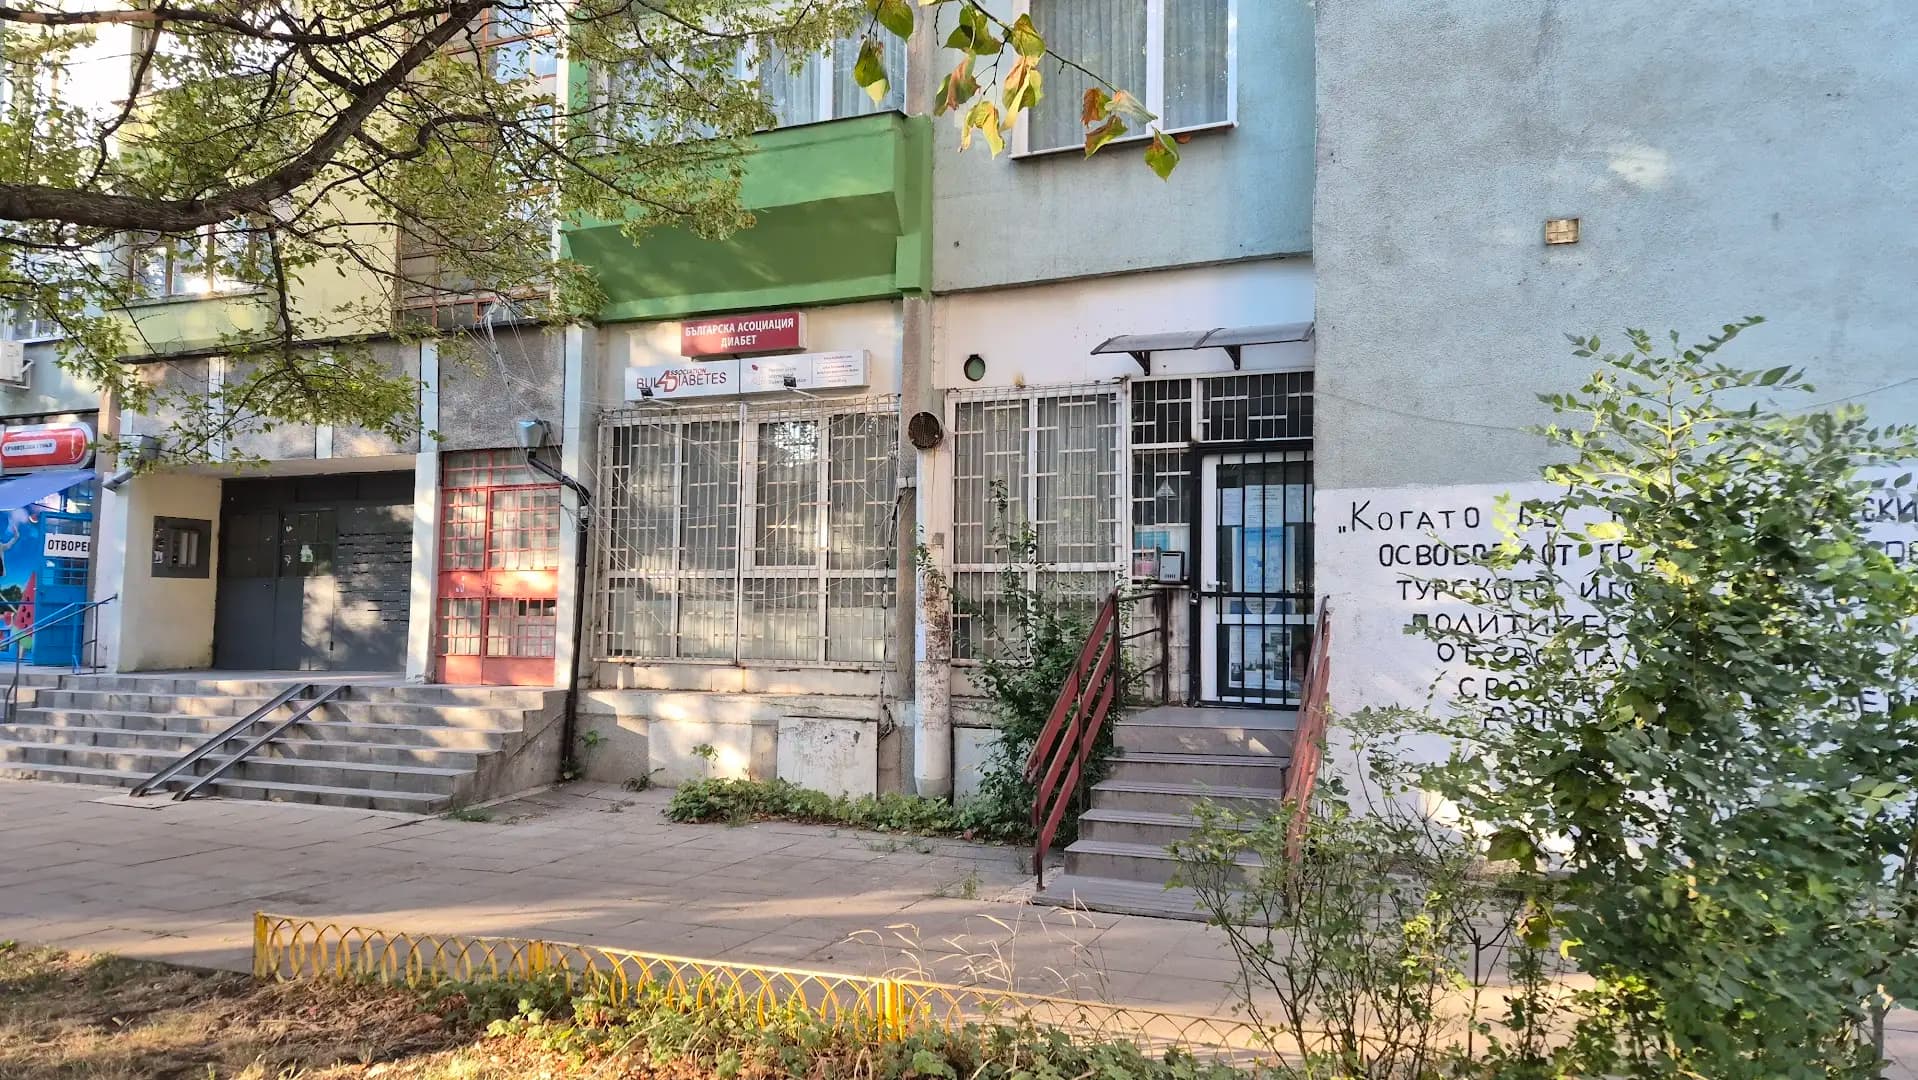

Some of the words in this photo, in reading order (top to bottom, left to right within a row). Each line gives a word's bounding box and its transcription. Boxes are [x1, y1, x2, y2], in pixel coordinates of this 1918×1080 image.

[685, 323, 735, 337] БЪЛГАРСКА
[737, 317, 794, 334] АСОЦИАЦИЯ
[720, 334, 757, 348] ДИАБЕТ
[1438, 642, 1476, 663] ОТ
